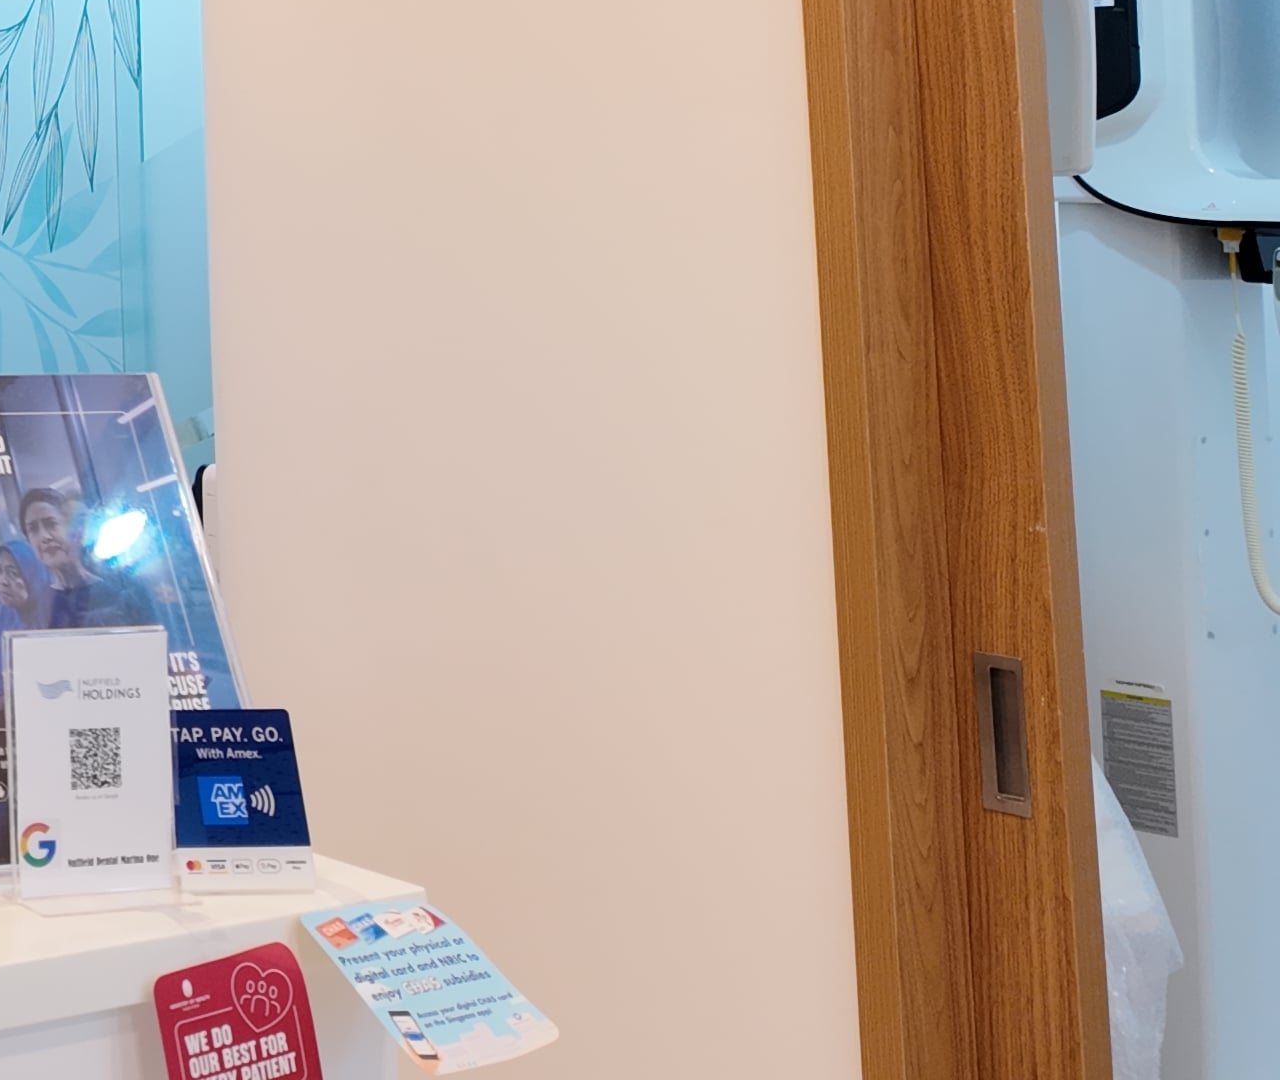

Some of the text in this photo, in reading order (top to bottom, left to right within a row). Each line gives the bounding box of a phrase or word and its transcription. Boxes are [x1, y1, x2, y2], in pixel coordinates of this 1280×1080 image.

[169, 651, 200, 673] IT'S
[82, 687, 142, 700] HOLDINGS
[170, 726, 283, 742] TAP. PAY. GO.
[196, 747, 263, 759] With Amex.
[96, 856, 119, 866] Dental
[120, 855, 144, 864] Marina
[338, 936, 466, 967] Present your physical or
[354, 952, 480, 985] digital card and NRIC to
[372, 988, 403, 1003] enjoy
[443, 969, 492, 987] subsidies
[184, 1023, 233, 1056] WE DO
[188, 1031, 289, 1079] OUR BEST FOR
[240, 1051, 297, 1080] PATIENT
